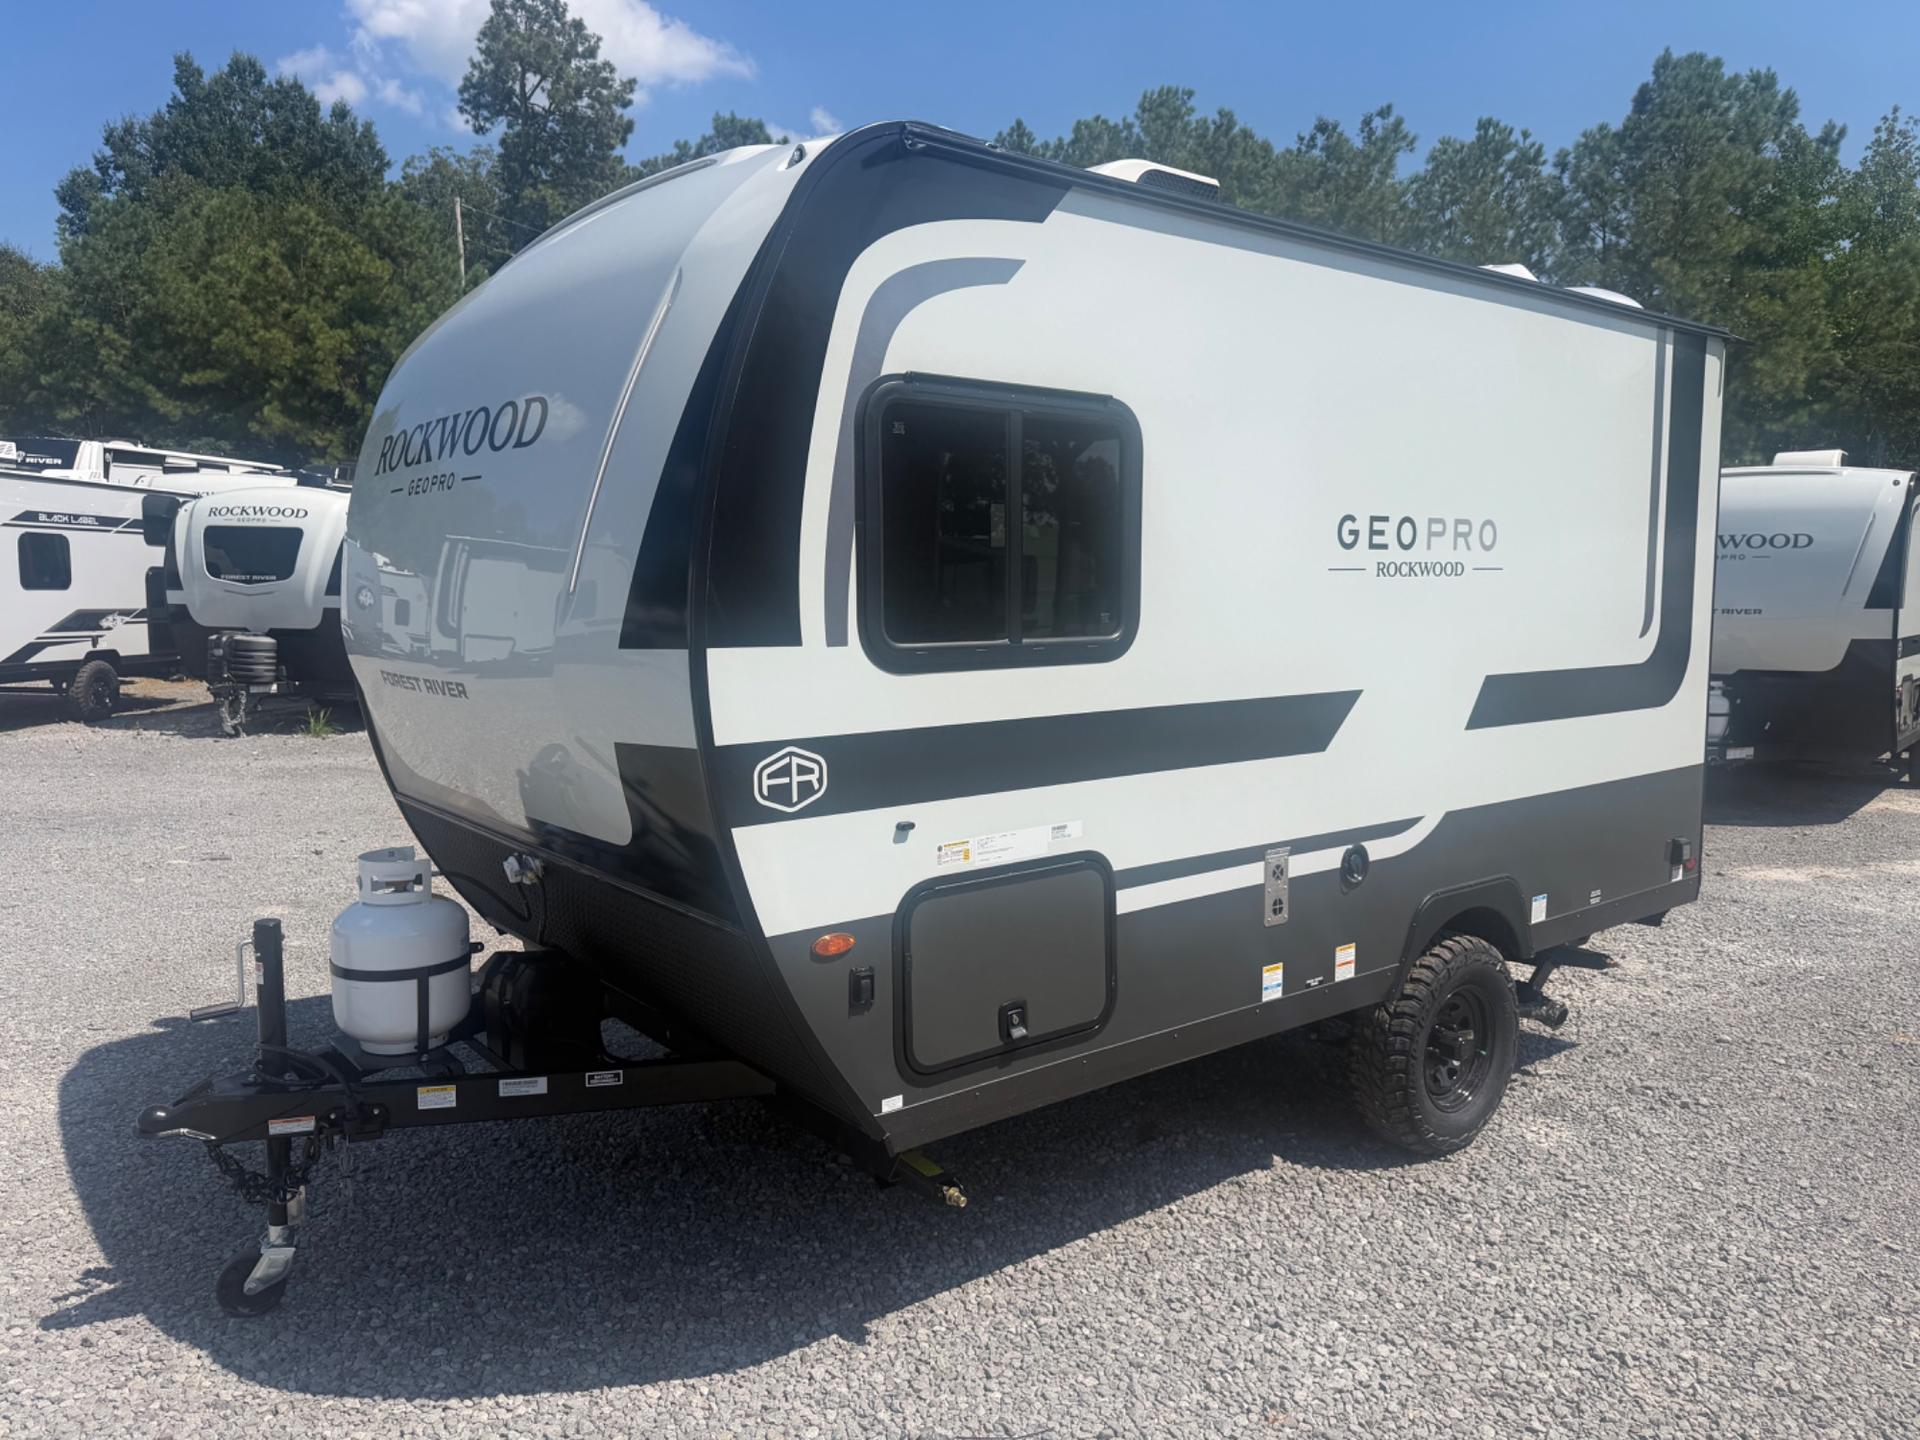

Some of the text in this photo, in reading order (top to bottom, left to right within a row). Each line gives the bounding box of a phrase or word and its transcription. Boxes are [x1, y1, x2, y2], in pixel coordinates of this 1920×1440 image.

[375, 396, 549, 476] ROCKWOOD
[25, 457, 62, 465] RIVER
[408, 472, 455, 497] GEOPRO
[38, 513, 99, 525] BLACK LABEL
[208, 506, 309, 519] ROCKWOOD
[1337, 513, 1497, 552] GEOPRO
[1376, 561, 1465, 578] ROCKWOOD
[380, 670, 470, 700] FOREST RIVER
